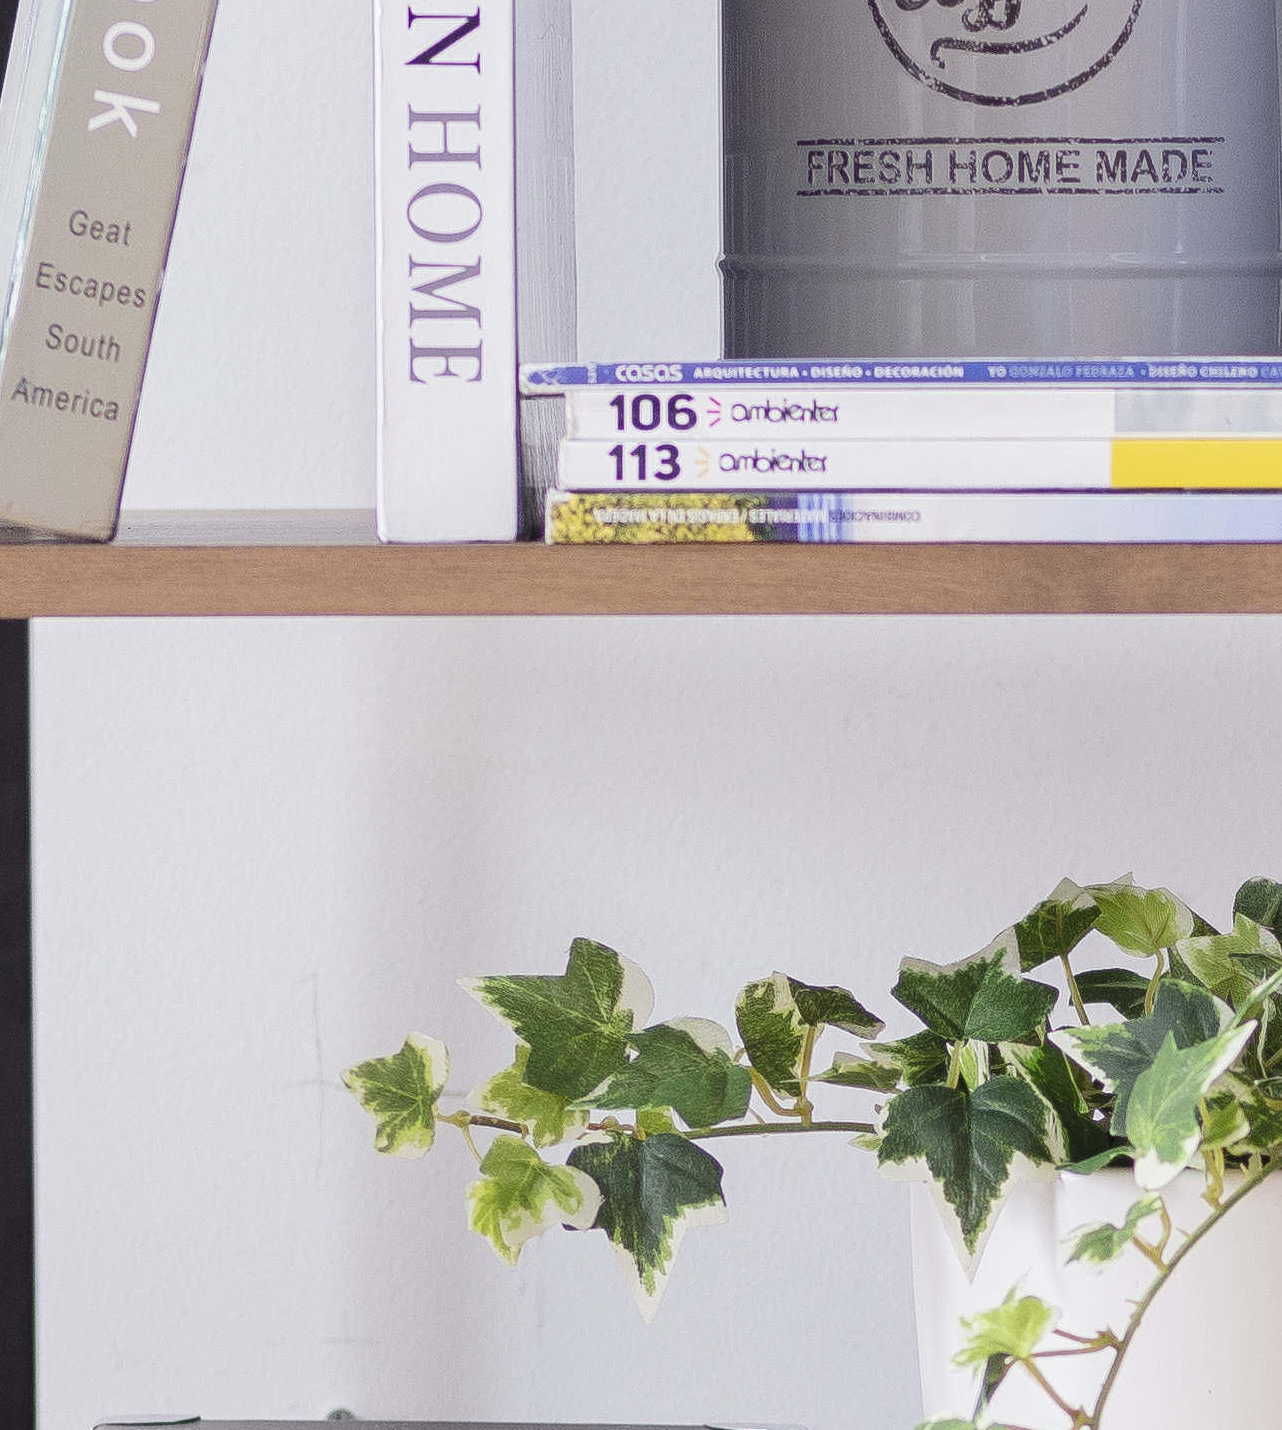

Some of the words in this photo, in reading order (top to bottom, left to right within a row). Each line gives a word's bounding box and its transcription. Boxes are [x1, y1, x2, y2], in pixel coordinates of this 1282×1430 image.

[803, 150, 938, 185] FRESH
[948, 150, 1082, 185] HOME
[1095, 149, 1216, 185] MADE
[68, 209, 131, 247] Geat
[406, 104, 483, 384] HOME
[35, 261, 146, 309] Escapes
[45, 323, 121, 362] South
[693, 366, 799, 381] ARQUITECTURA
[810, 364, 862, 380] DISEÑO
[874, 364, 964, 379] DECORACIÓN
[1148, 362, 1198, 379] DISEÑO
[1200, 364, 1258, 379] CHILENO
[11, 376, 120, 421] America
[610, 393, 698, 431] 106
[609, 443, 681, 481] 113
